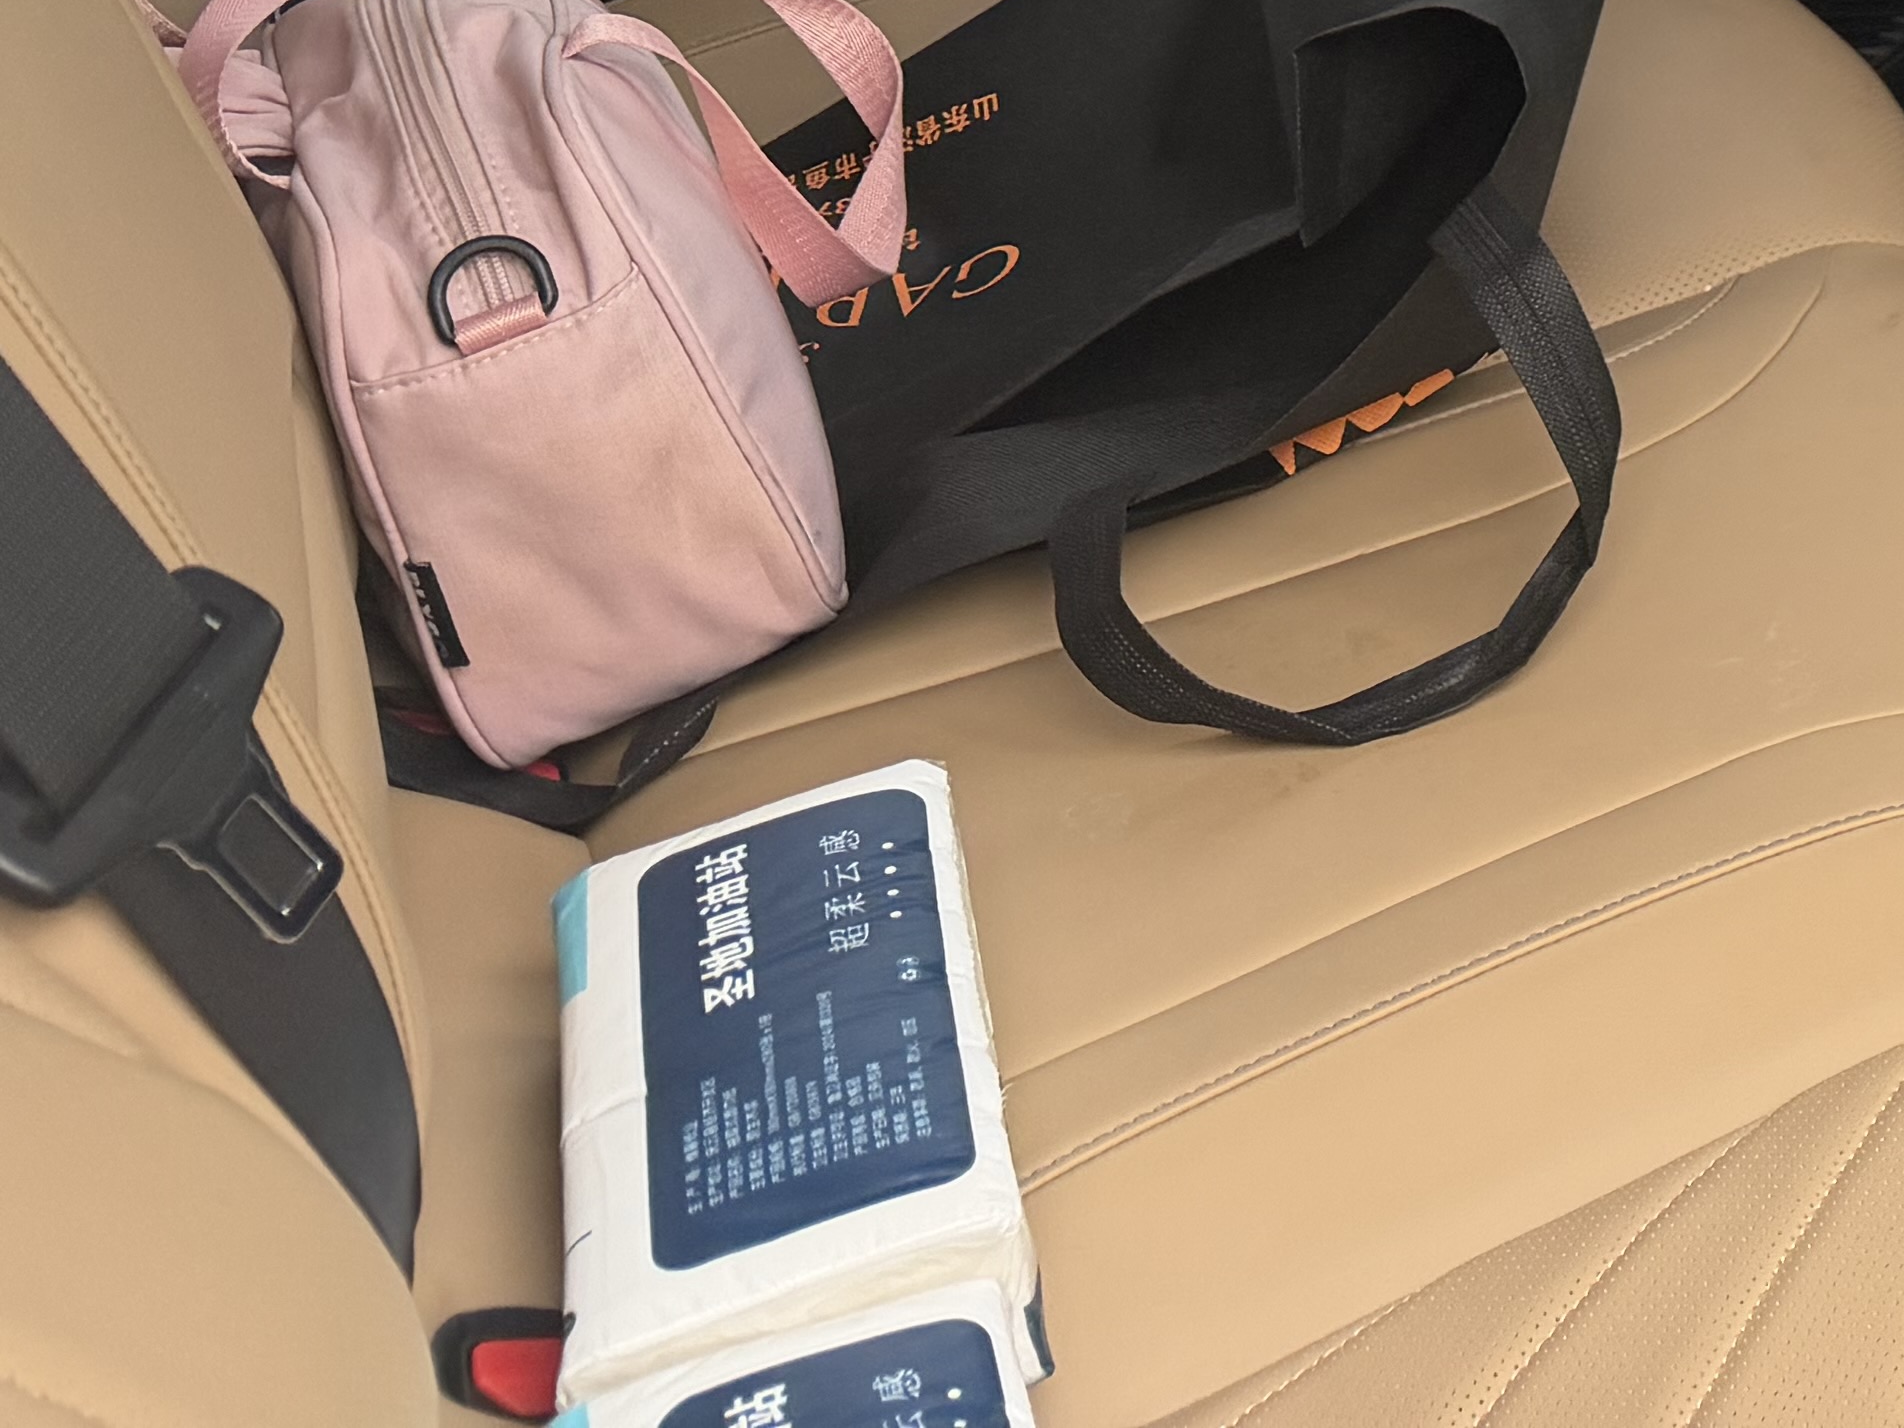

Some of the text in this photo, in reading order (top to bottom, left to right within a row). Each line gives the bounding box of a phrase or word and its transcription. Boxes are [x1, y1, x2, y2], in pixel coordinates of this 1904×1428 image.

[696, 843, 755, 1014] 圣地加油站
[819, 828, 871, 954] 超柔云感
